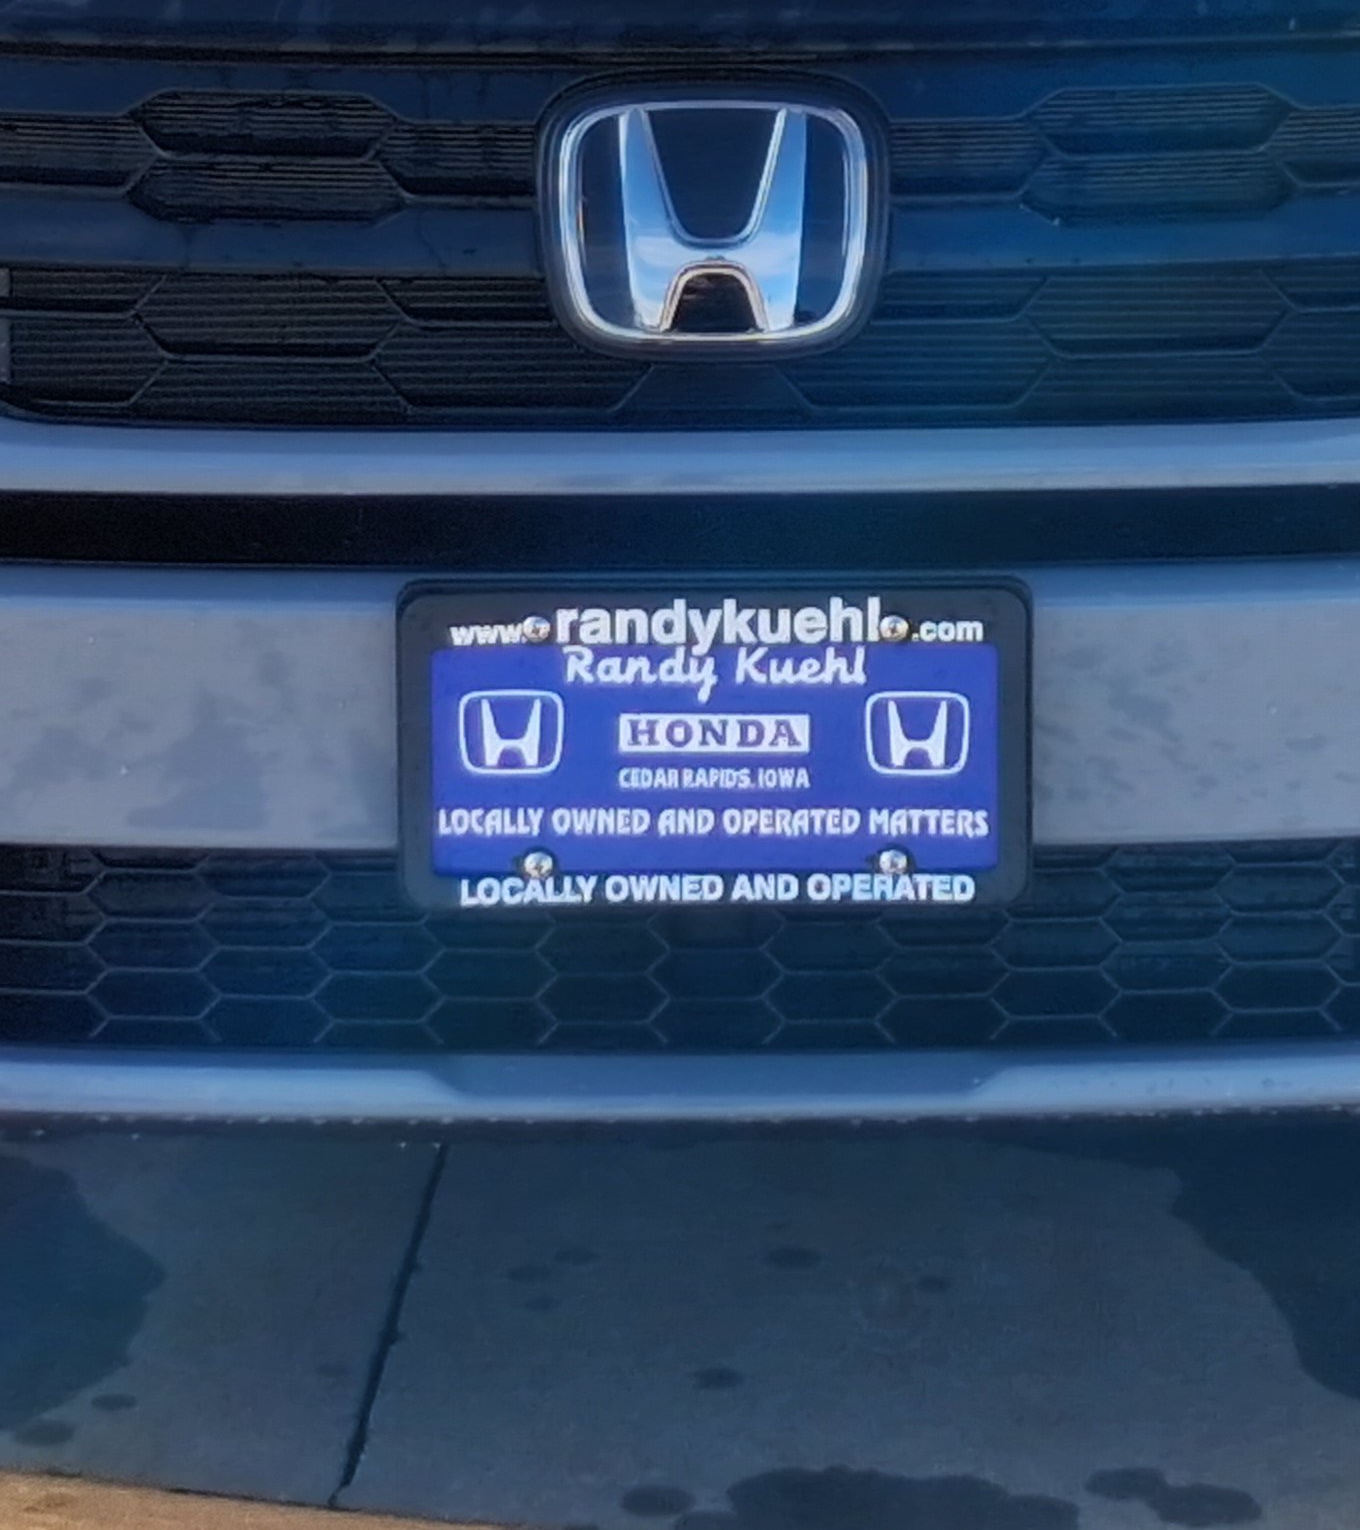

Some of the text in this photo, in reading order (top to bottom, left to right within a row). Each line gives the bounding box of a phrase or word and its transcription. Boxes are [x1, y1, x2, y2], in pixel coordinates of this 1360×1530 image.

[563, 645, 867, 703] Randy Kuehl
[627, 719, 801, 748] HONDA
[619, 767, 679, 789] CEDAR
[758, 767, 811, 789] IOWA
[438, 807, 989, 838] LOCALLY OWNED AND OPERATED MATTERS
[460, 873, 975, 907] LOCALLY OWNED AND OPERATED
